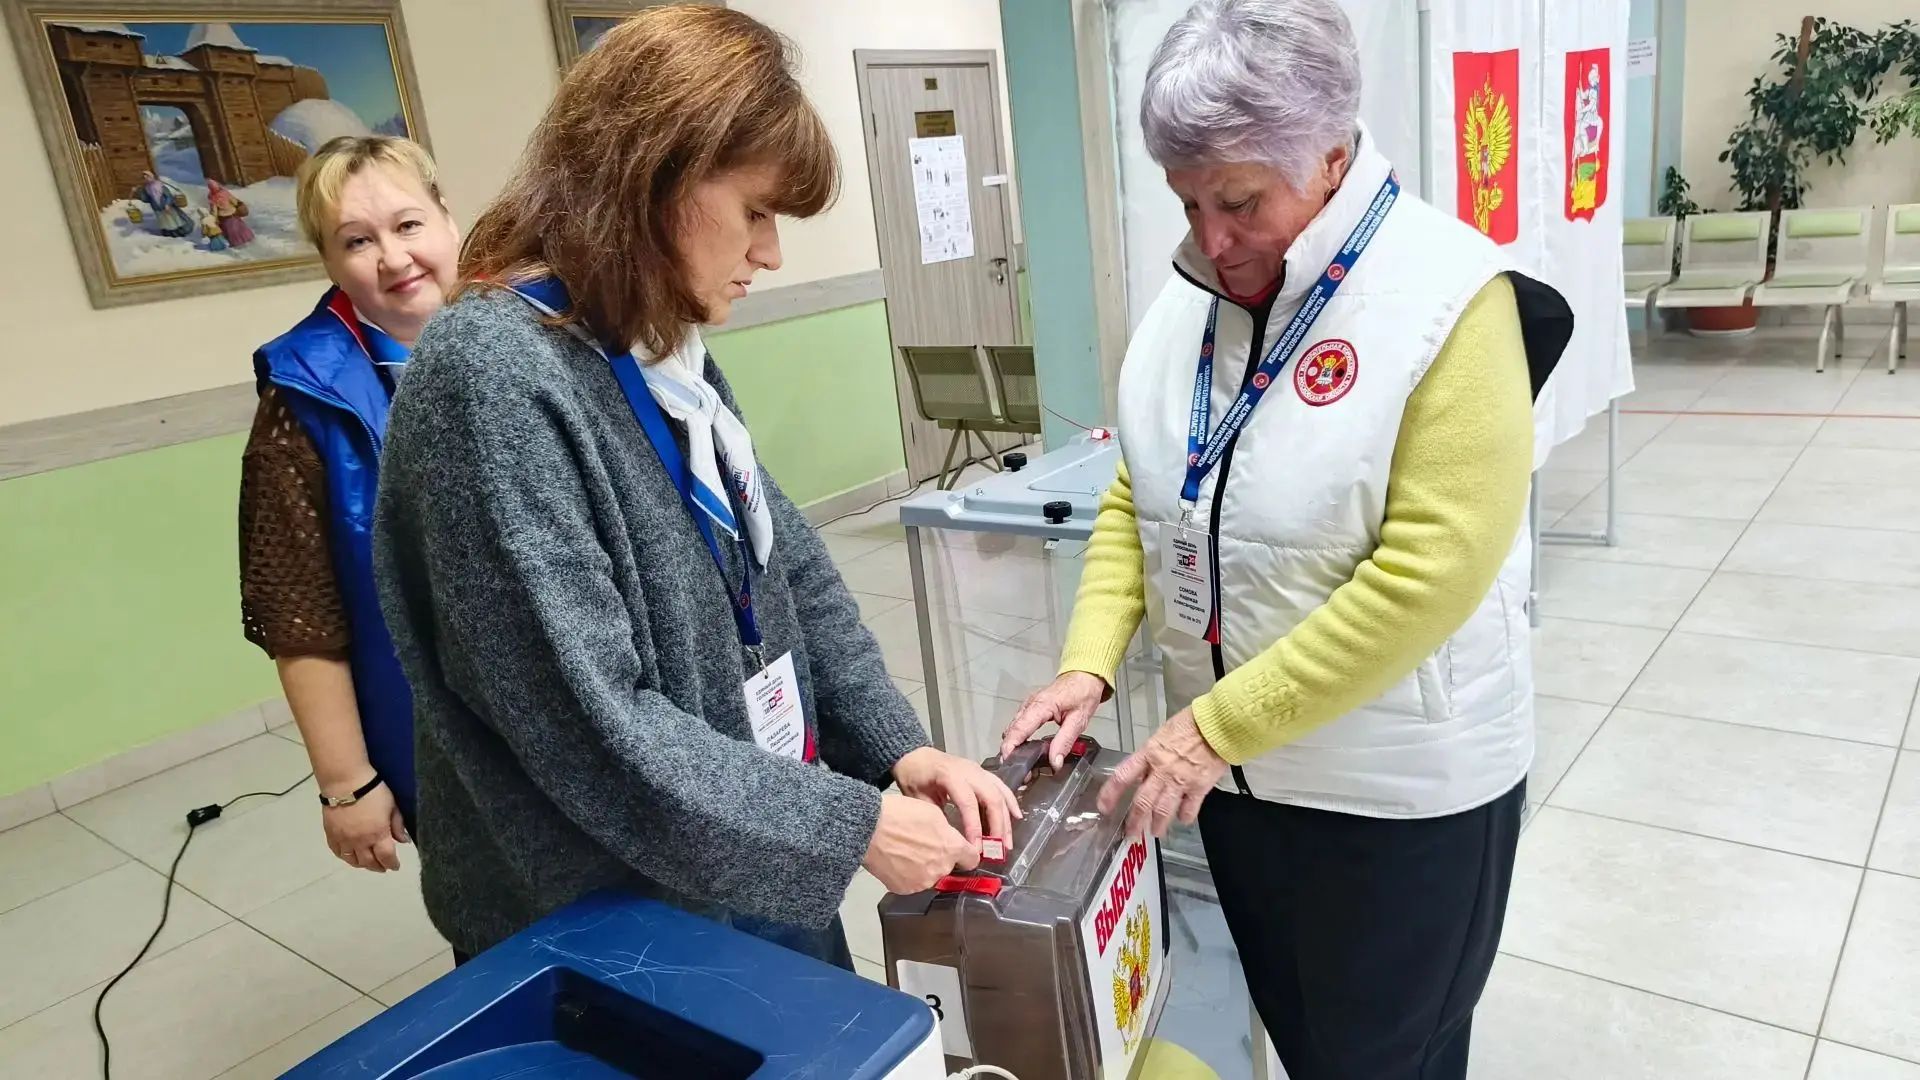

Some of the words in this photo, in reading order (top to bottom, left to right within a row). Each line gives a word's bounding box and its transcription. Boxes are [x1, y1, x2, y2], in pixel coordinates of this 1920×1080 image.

[1267, 317, 1302, 364] ИЗБИРАТЕЛЬНАЯ
[1299, 285, 1323, 319] КОМИССИЯ
[1278, 321, 1307, 362] МОСКОВСКОЙ
[1304, 297, 1326, 324] ОБЛАСТИ
[1193, 373, 1203, 410] МОСКОВСКОЙ
[1201, 365, 1211, 411] ИЗБИРАТЕЛЬНАЯ
[1196, 422, 1229, 468] ИЗБИРАТЕЛЬНАЯ
[1225, 393, 1250, 424] КОМИССИЯ
[1197, 411, 1207, 445] КОМИССИЯ
[1207, 428, 1235, 465] МОСКОВСКОЙ
[1231, 404, 1252, 430] ОБЛАСТИ
[1095, 828, 1147, 958] ВЫБОРЫ
